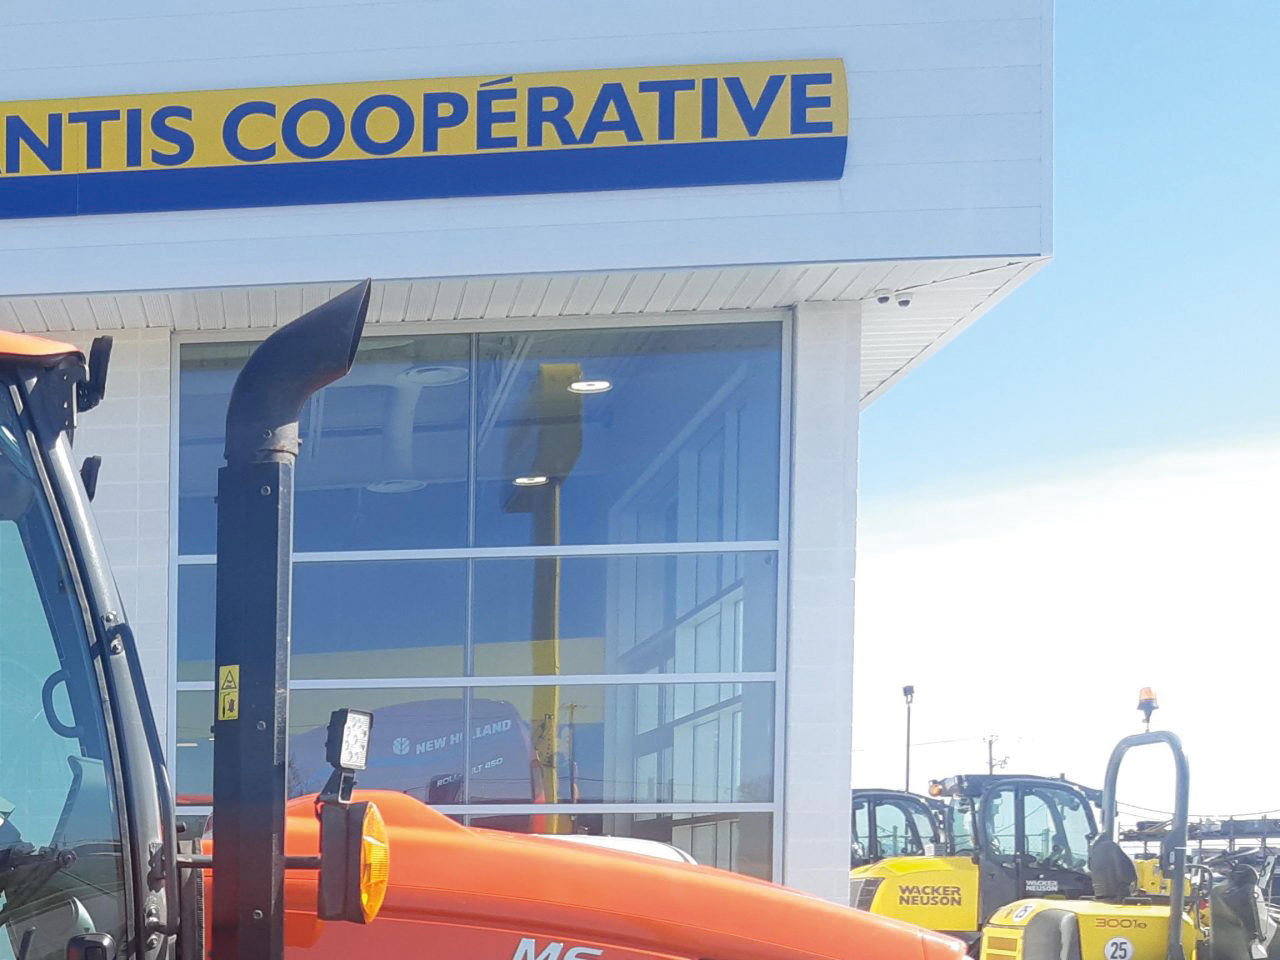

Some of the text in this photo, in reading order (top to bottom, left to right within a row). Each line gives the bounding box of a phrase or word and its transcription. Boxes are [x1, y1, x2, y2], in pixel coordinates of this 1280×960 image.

[222, 72, 834, 162] COOPÉRATIVE
[416, 735, 447, 755] NEW
[899, 885, 961, 896] WACKER
[899, 896, 962, 906] NEUSON
[1110, 941, 1127, 960] 25
